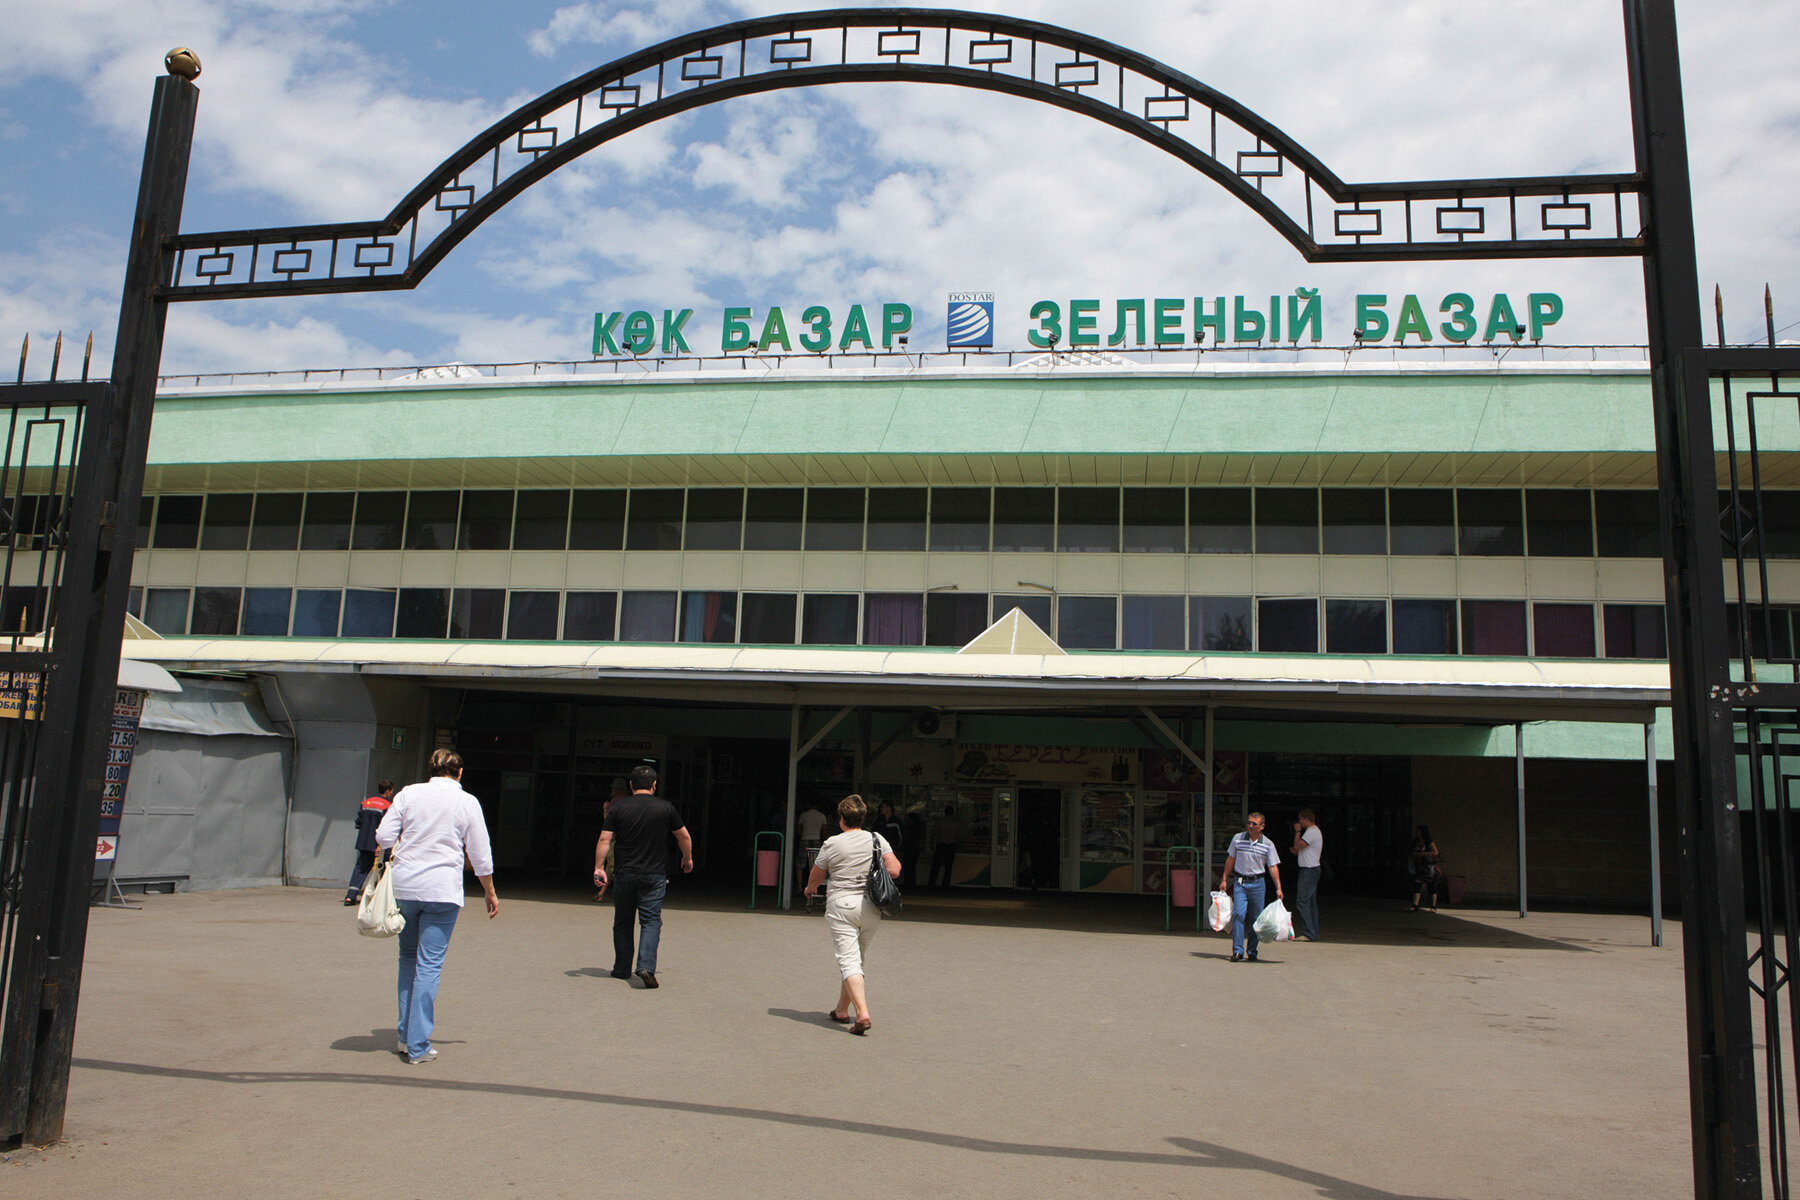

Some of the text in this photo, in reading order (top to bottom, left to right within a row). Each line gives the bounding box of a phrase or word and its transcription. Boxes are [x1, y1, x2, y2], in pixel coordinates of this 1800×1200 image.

[948, 292, 993, 303] DOSTAR
[592, 302, 914, 356] КӨК БАЗАР
[1027, 287, 1564, 348] ЗЕЛЕНЫЙ БАЗАР
[610, 740, 653, 751] МОЛОКО
